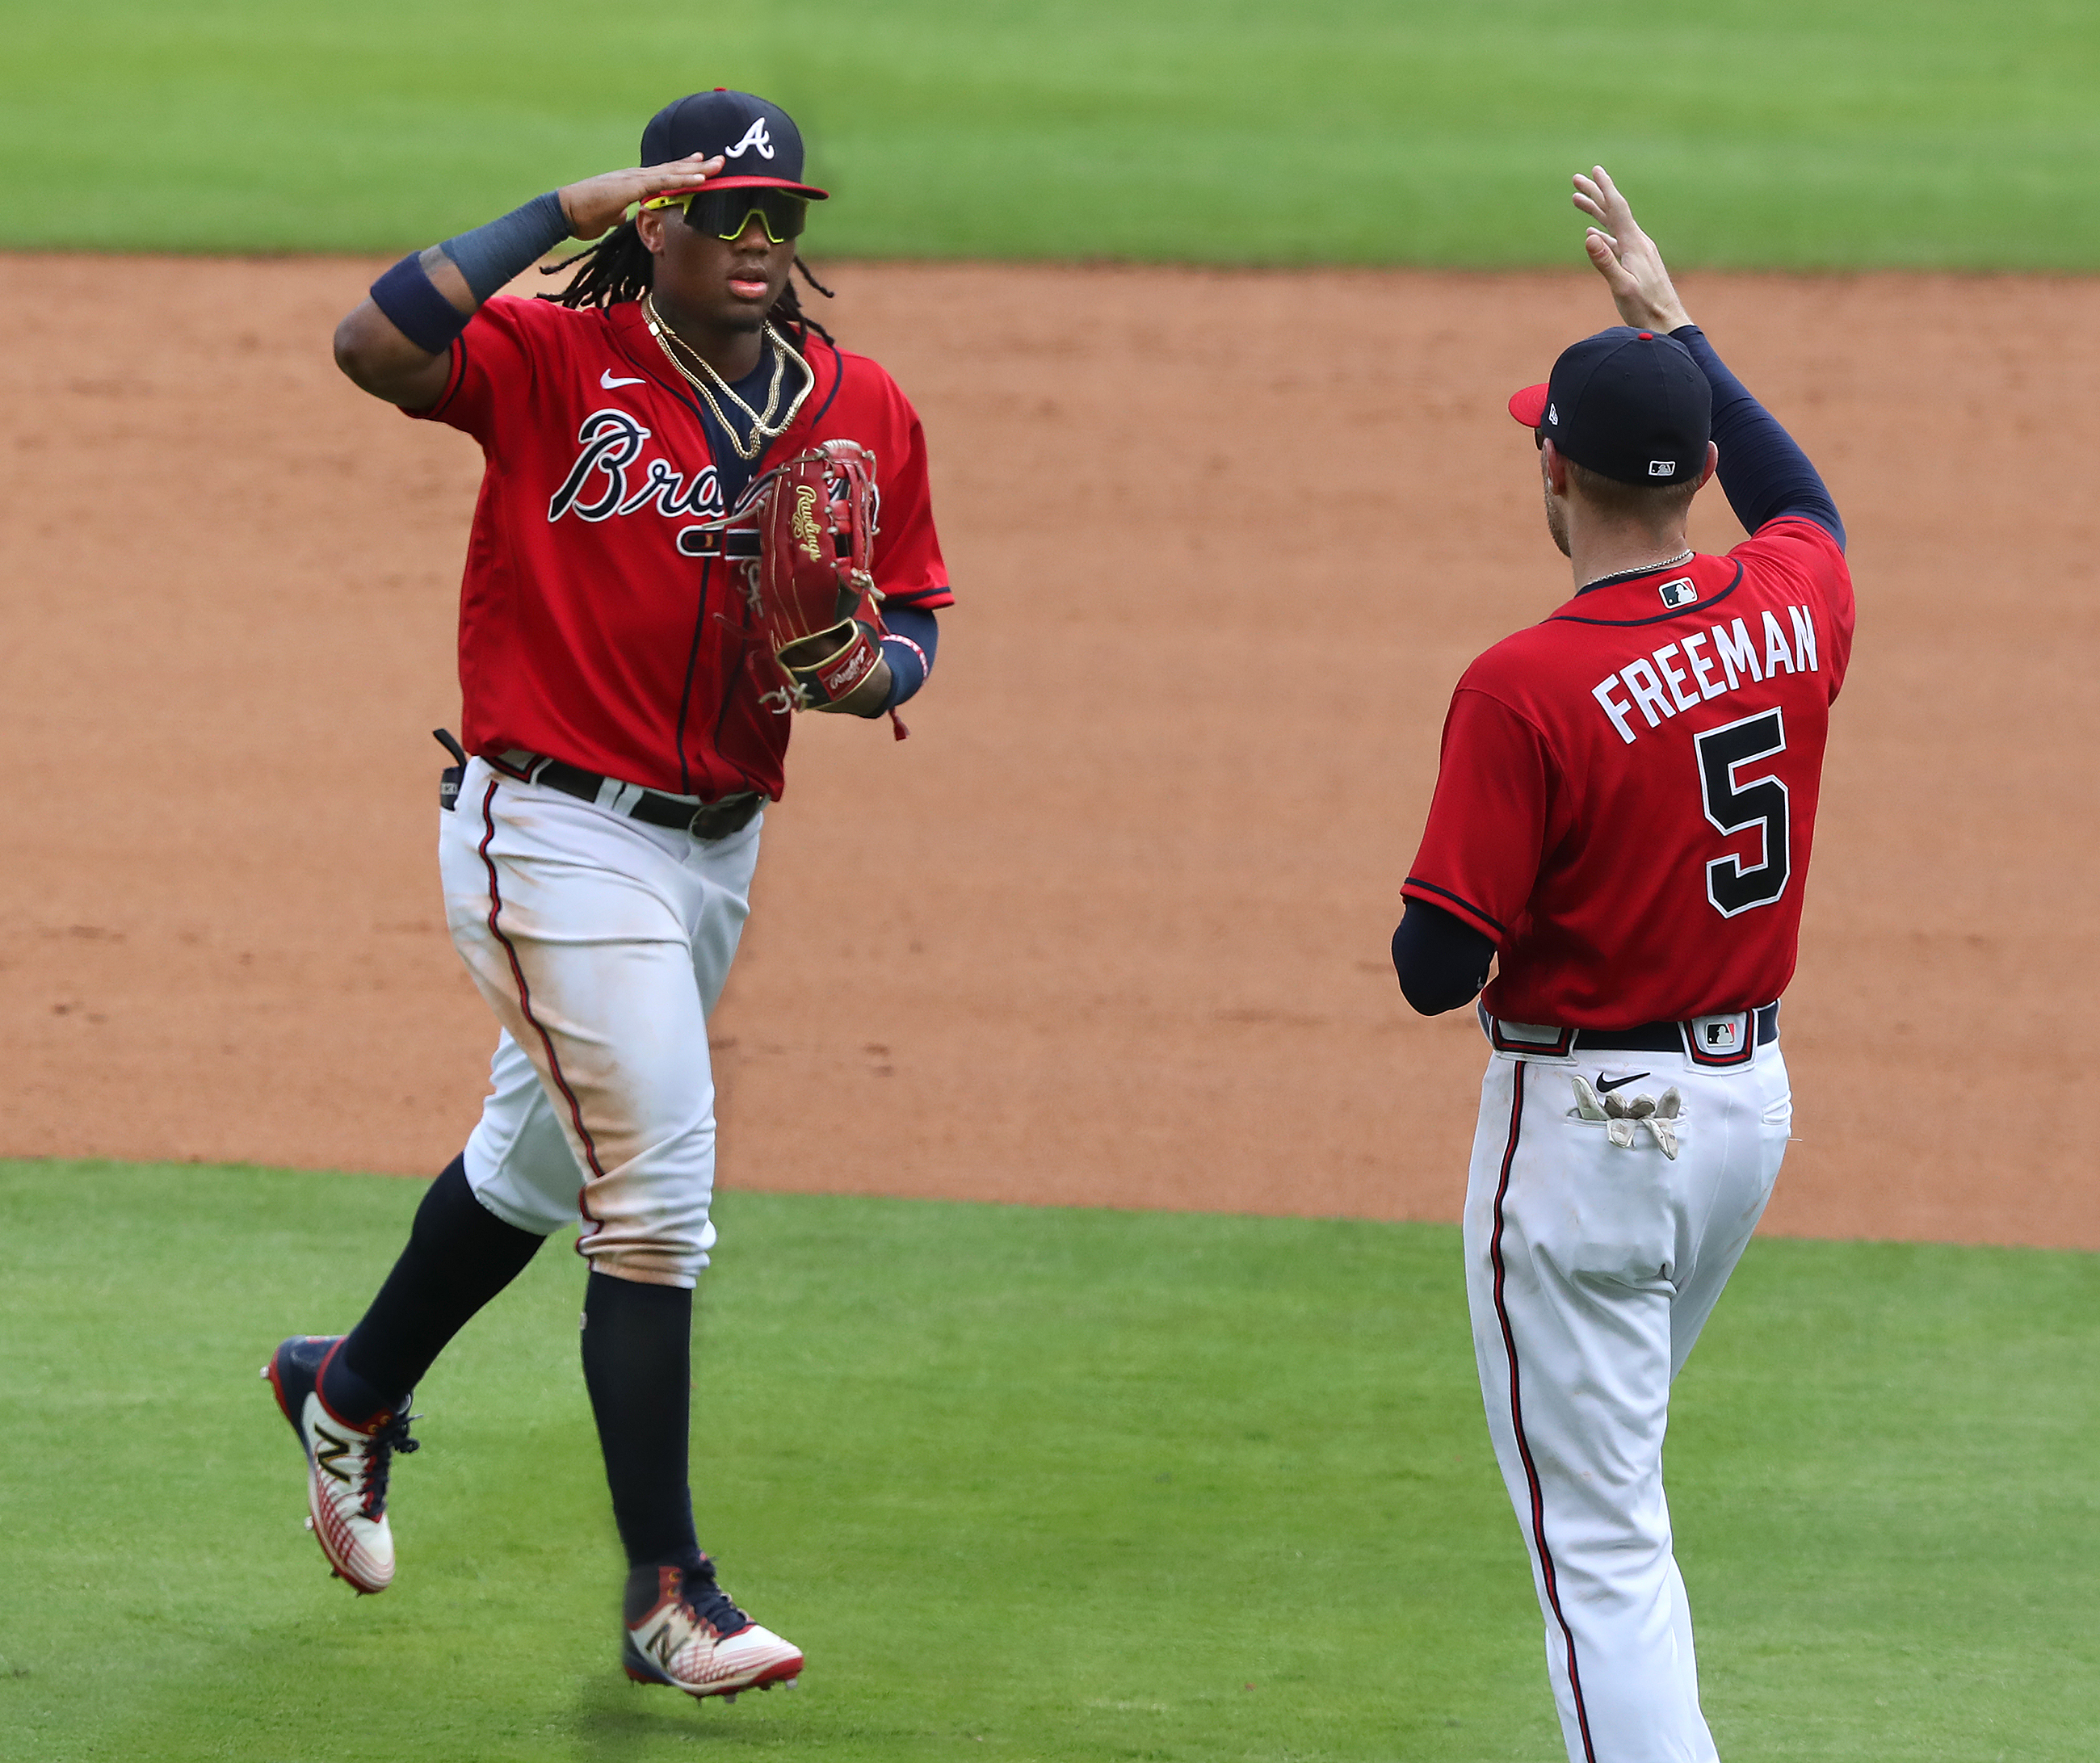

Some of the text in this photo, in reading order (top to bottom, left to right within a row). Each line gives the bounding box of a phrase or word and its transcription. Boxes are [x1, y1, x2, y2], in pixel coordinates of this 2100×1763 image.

[724, 116, 775, 160] A
[792, 485, 822, 563] Rawlings
[1591, 604, 1819, 744] FREEMAN
[1694, 705, 1791, 919] 5
